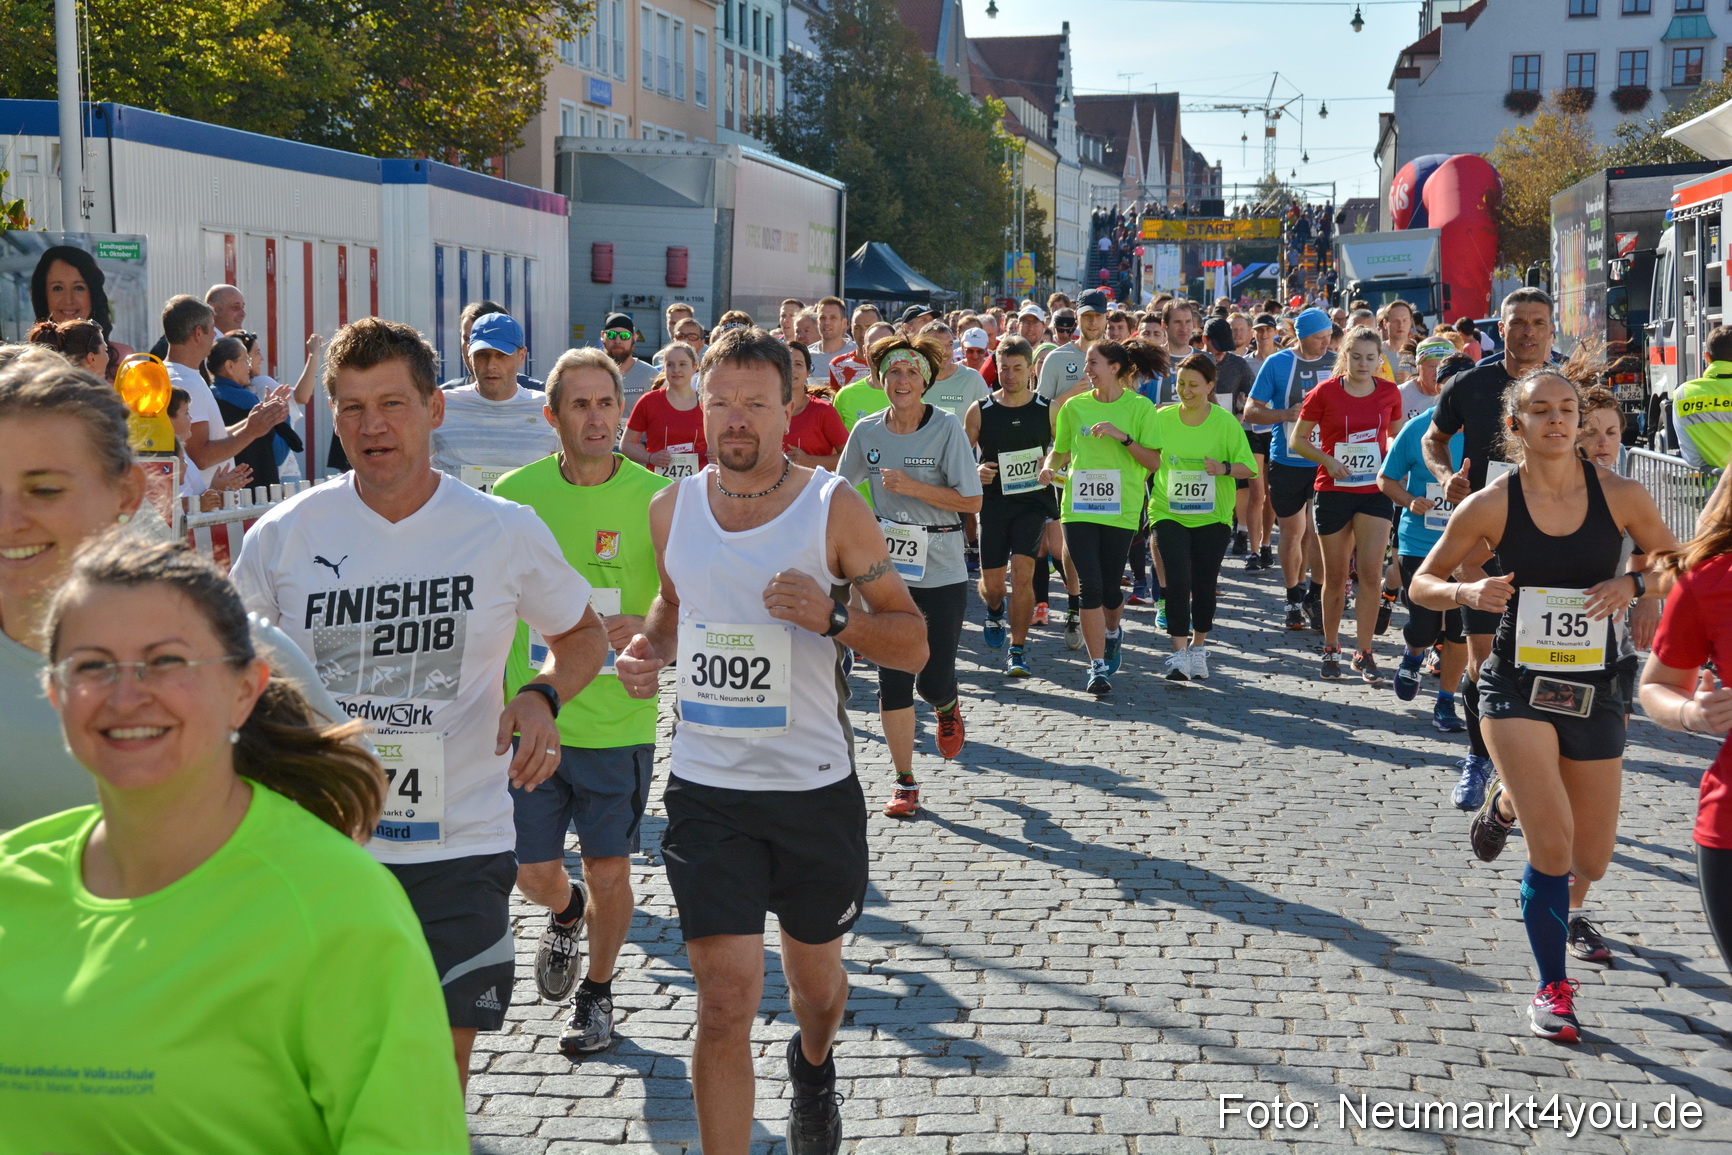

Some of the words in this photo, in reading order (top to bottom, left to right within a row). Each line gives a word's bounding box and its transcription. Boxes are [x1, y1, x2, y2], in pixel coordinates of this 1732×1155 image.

[1186, 223, 1236, 236] START
[99, 242, 139, 251] Landtagswahl
[1367, 253, 1412, 264] BOCK
[1682, 398, 1732, 412] Org.-Le
[904, 457, 935, 466] BOCK
[1341, 455, 1375, 469] 2472
[661, 464, 693, 478] 2473
[1006, 460, 1038, 478] 2027
[1079, 482, 1114, 497] 2168
[1174, 482, 1208, 497] 2167
[1433, 496, 1455, 511] 20
[896, 511, 912, 522] 19.
[886, 537, 918, 557] 073
[305, 575, 474, 629] FINISHER
[1546, 595, 1587, 606] BOCK
[1541, 611, 1589, 637] 135
[372, 617, 455, 657] 2018
[706, 632, 755, 647] BOCK
[1549, 651, 1576, 663] Elisa
[691, 652, 771, 690] 3092
[697, 692, 718, 701] PARTL
[719, 694, 754, 703] Neumarkt
[385, 768, 422, 804] 74
[374, 825, 411, 839] nard
[475, 1000, 501, 1011] adidas
